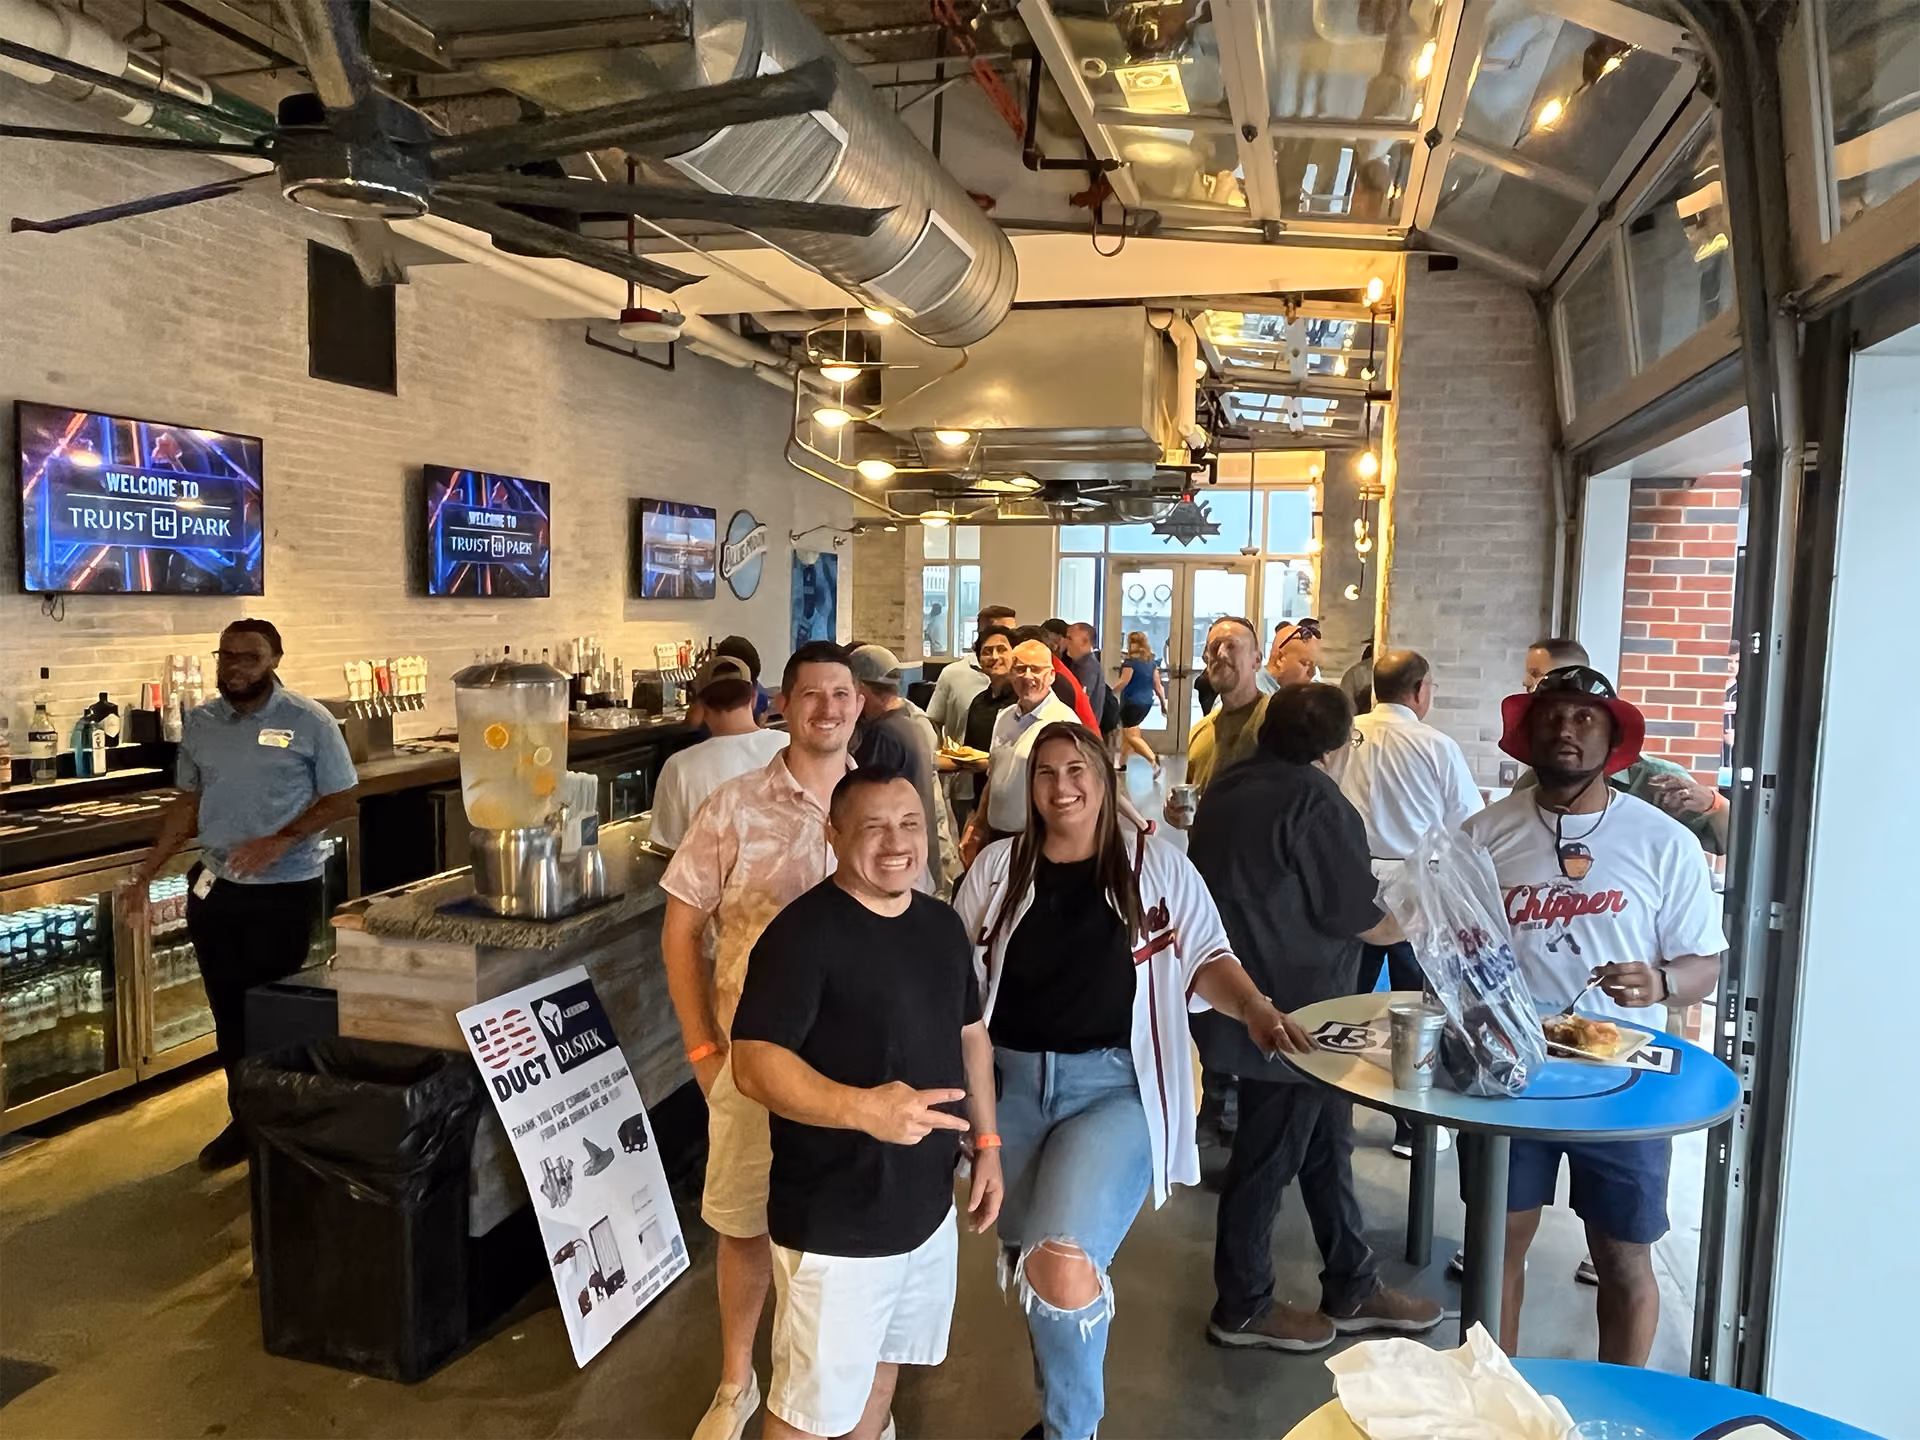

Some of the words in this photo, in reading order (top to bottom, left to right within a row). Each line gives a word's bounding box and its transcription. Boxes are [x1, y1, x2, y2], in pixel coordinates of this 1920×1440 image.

[106, 472, 177, 498] WELCOME
[182, 481, 199, 499] TO
[68, 507, 148, 532] TRUIST
[182, 516, 232, 537] PARK
[468, 511, 505, 528] WELCOME
[506, 514, 517, 529] TO
[450, 536, 490, 553] TRUIST
[506, 540, 533, 556] PARK
[1504, 885, 1628, 929] Chipper
[491, 1053, 551, 1102] DUCT
